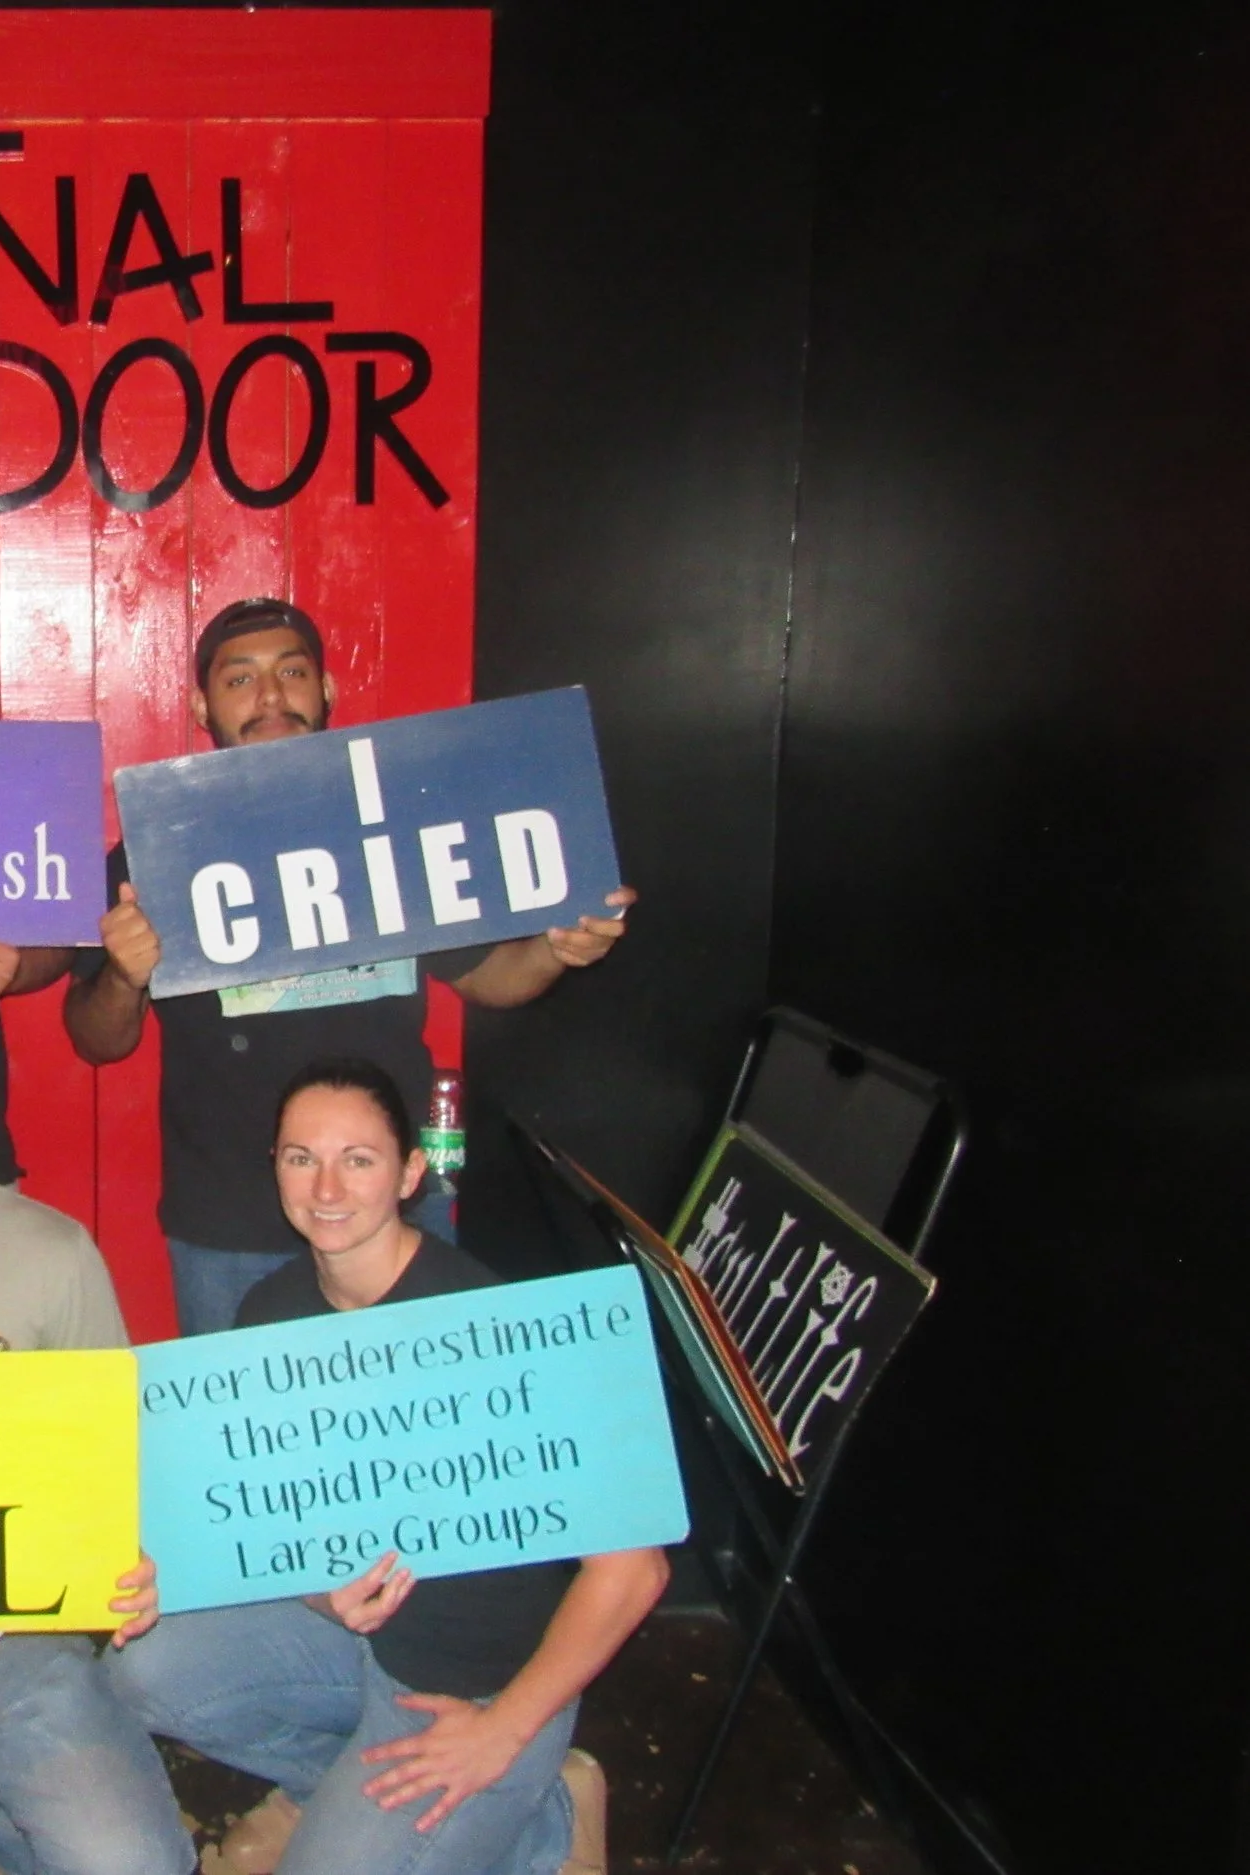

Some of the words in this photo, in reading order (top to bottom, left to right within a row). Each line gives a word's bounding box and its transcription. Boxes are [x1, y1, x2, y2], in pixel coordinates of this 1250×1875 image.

[348, 737, 385, 826] I
[190, 808, 568, 965] CRIED
[137, 1366, 251, 1418] ever
[263, 1300, 633, 1394] Underestimate
[219, 1416, 300, 1461] the
[310, 1388, 471, 1448] Power
[486, 1370, 538, 1415] of
[205, 1461, 361, 1525] Stupid
[370, 1437, 527, 1499] People
[535, 1431, 580, 1473] in
[236, 1527, 381, 1579] Large
[392, 1500, 569, 1559] Groups
